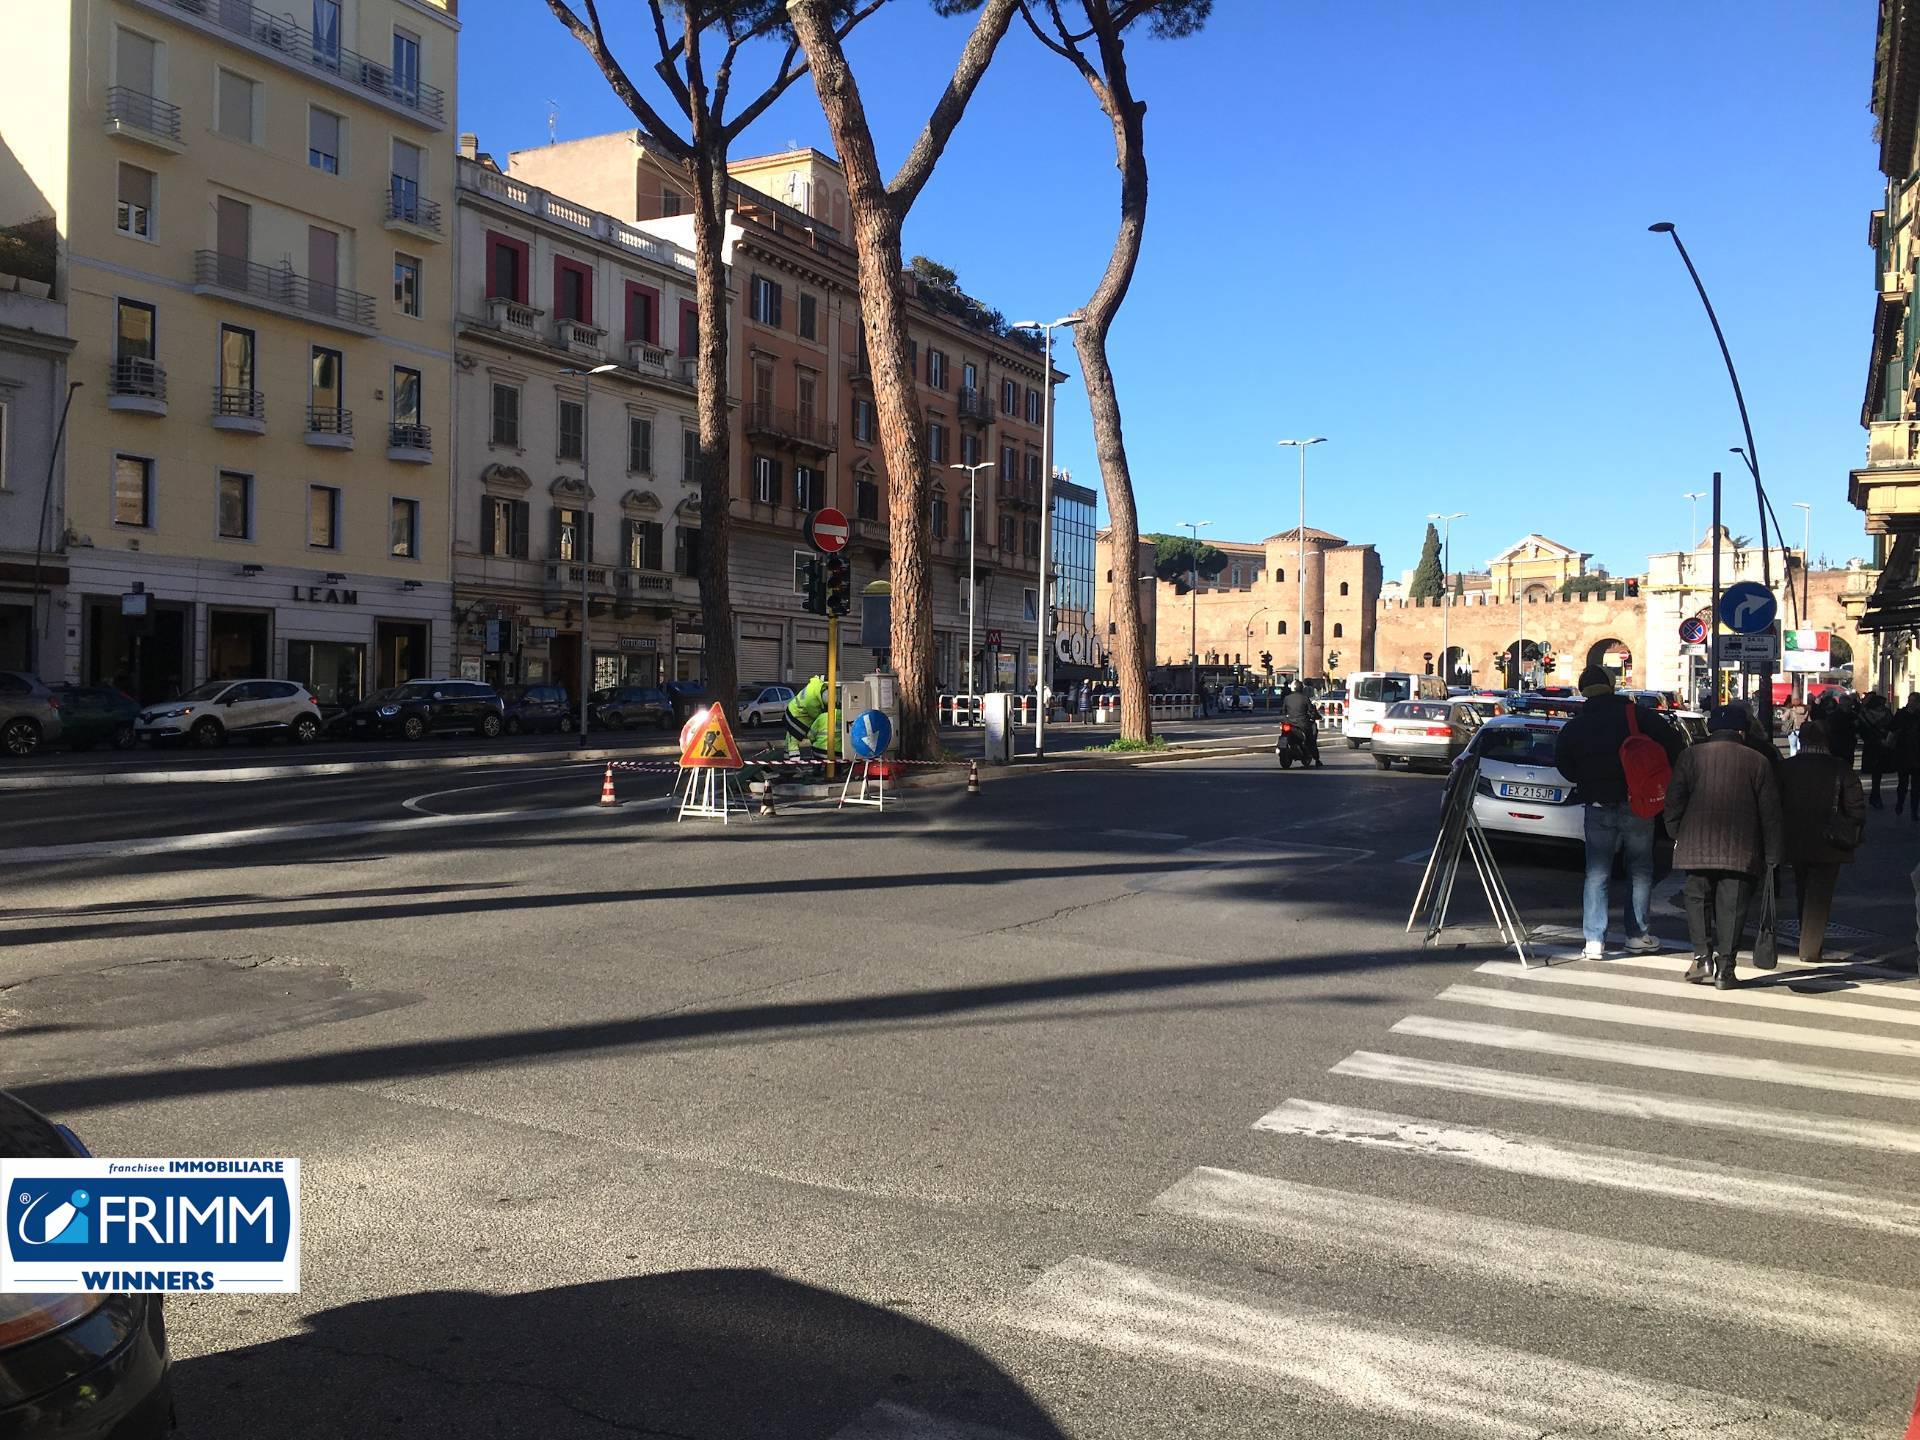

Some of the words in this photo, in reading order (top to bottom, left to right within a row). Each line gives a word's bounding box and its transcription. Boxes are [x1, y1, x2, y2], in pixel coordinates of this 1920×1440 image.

[293, 585, 357, 605] LEAM
[988, 632, 1001, 643] M
[1056, 611, 1103, 667] coin
[1508, 785, 1520, 795] EX
[1523, 787, 1554, 798] 215JP
